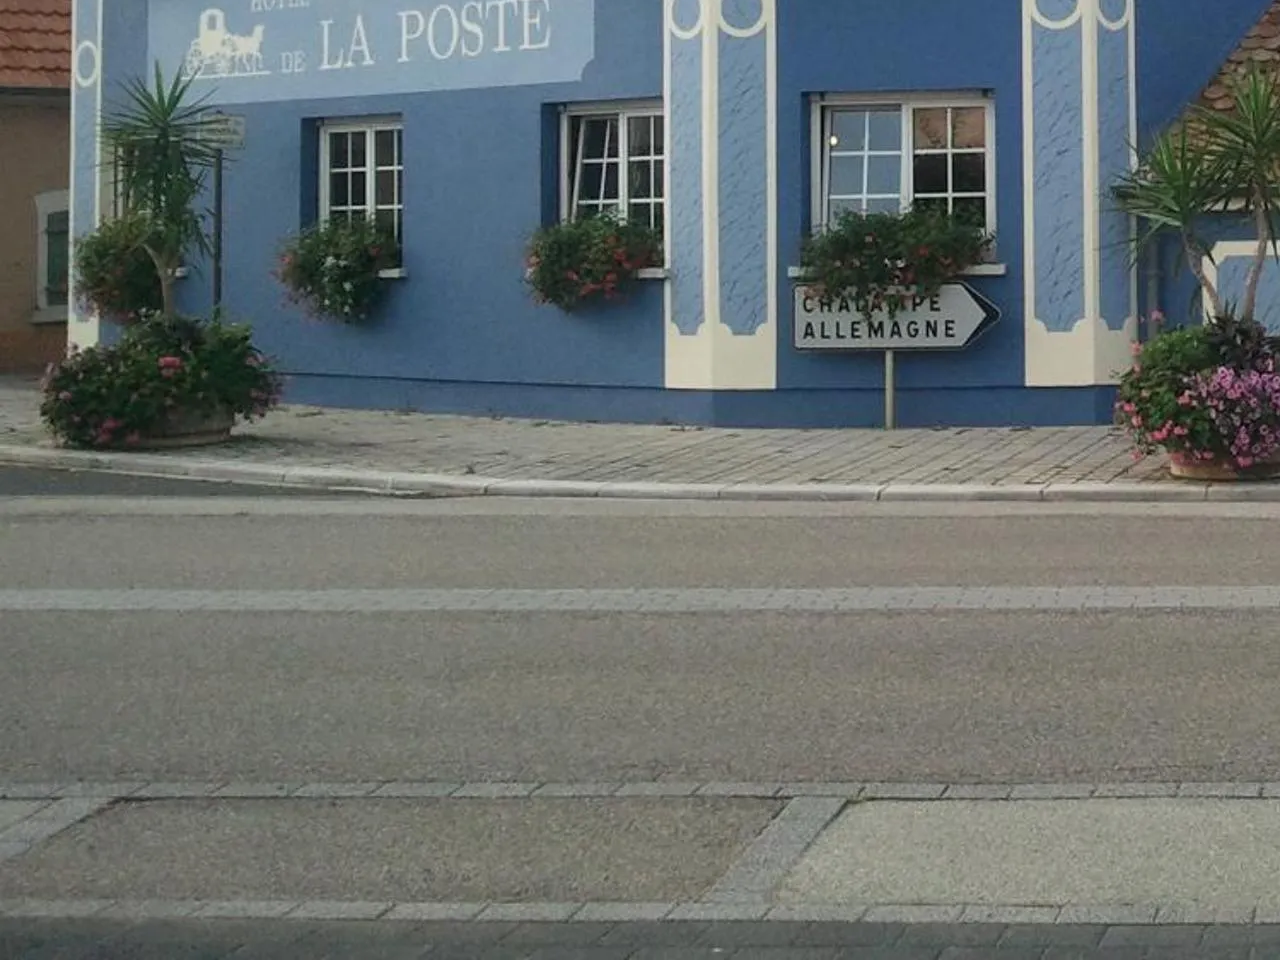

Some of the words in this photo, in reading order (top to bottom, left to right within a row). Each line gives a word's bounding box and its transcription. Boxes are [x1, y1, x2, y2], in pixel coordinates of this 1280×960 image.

[281, 50, 306, 74] DE
[318, 14, 375, 71] LA
[803, 292, 941, 314] CHALAPE
[803, 320, 956, 340] ALLEMAGNE
